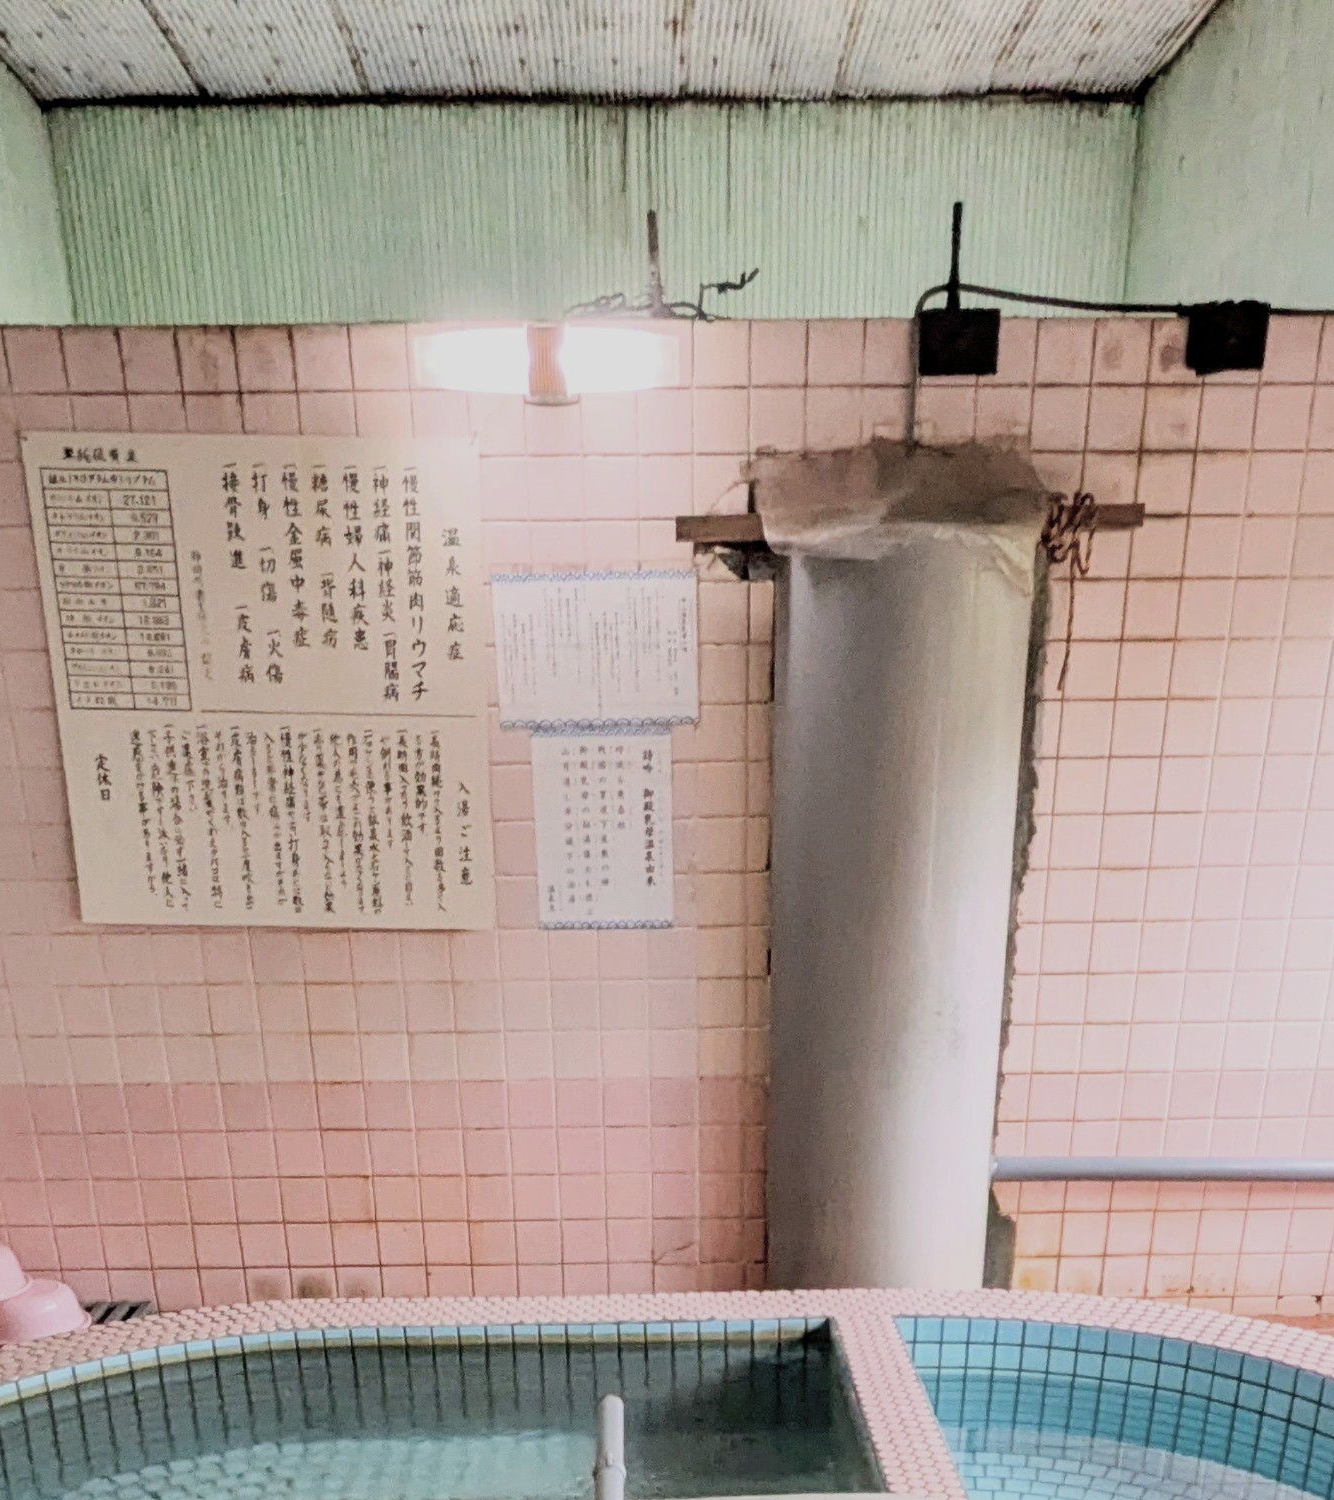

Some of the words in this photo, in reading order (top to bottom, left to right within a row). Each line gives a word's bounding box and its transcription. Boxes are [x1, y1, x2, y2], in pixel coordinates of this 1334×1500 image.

[442, 528, 465, 661] 温泉適応症
[95, 753, 112, 801] 定休日
[457, 781, 473, 886] 入湯ご注意
